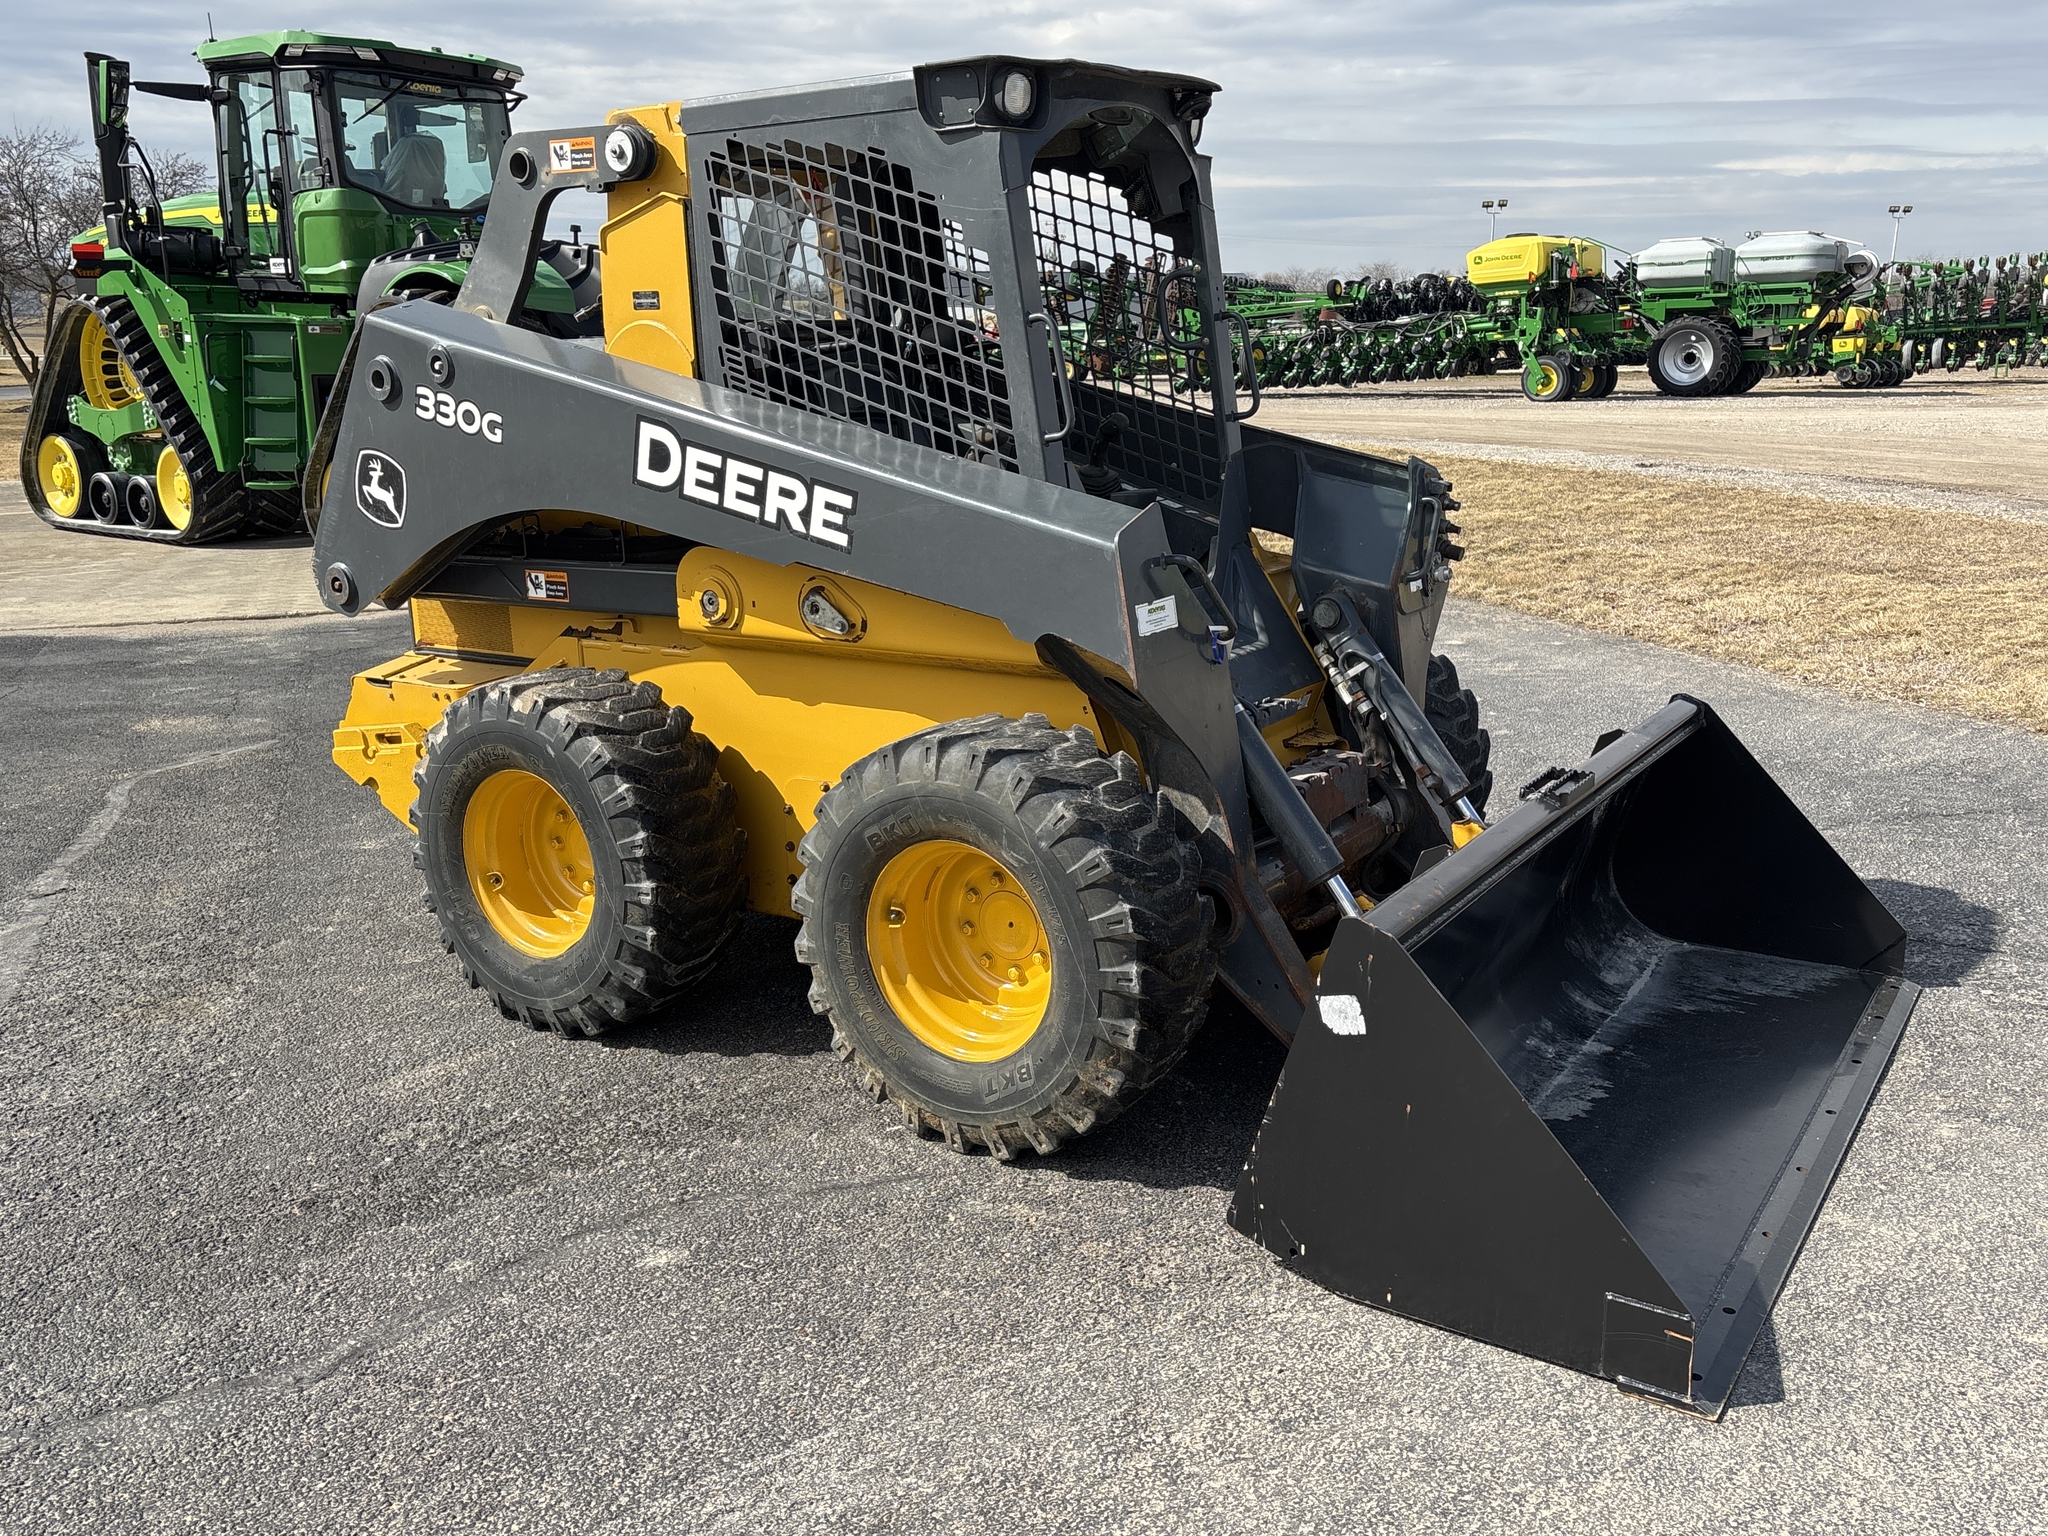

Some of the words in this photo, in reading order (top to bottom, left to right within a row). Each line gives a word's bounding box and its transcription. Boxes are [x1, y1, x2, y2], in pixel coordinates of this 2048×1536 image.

[415, 385, 503, 444] 330G
[635, 418, 855, 549] DEERE
[865, 812, 918, 853] BKT
[833, 921, 869, 1008] POWER
[860, 1011, 908, 1062] SKID
[984, 1062, 1033, 1098] BKT
